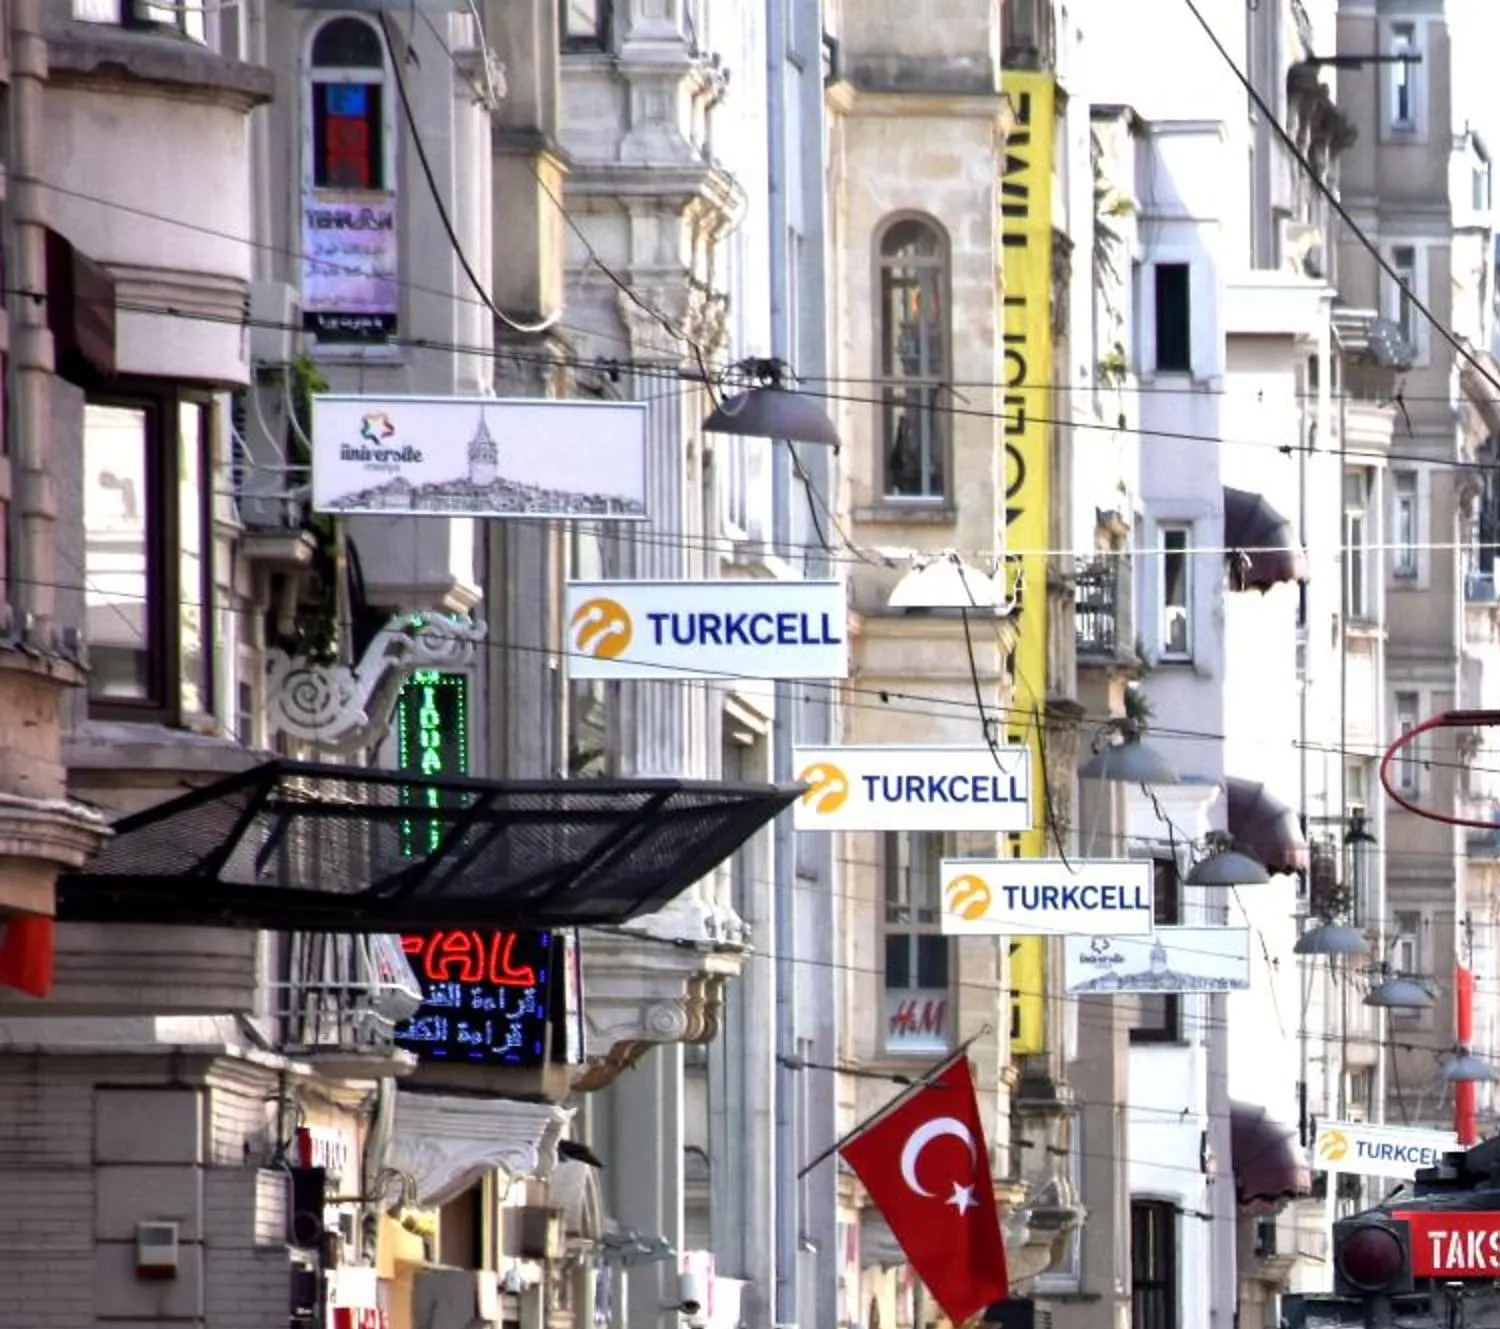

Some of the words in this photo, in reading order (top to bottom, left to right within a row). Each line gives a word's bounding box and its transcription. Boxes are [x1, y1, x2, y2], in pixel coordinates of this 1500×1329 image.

[646, 612, 841, 646] TURKCELL
[862, 775, 1028, 803] TURKCELL
[1002, 885, 1150, 910] TURKCELL
[1356, 1140, 1444, 1166] TURKCEL
